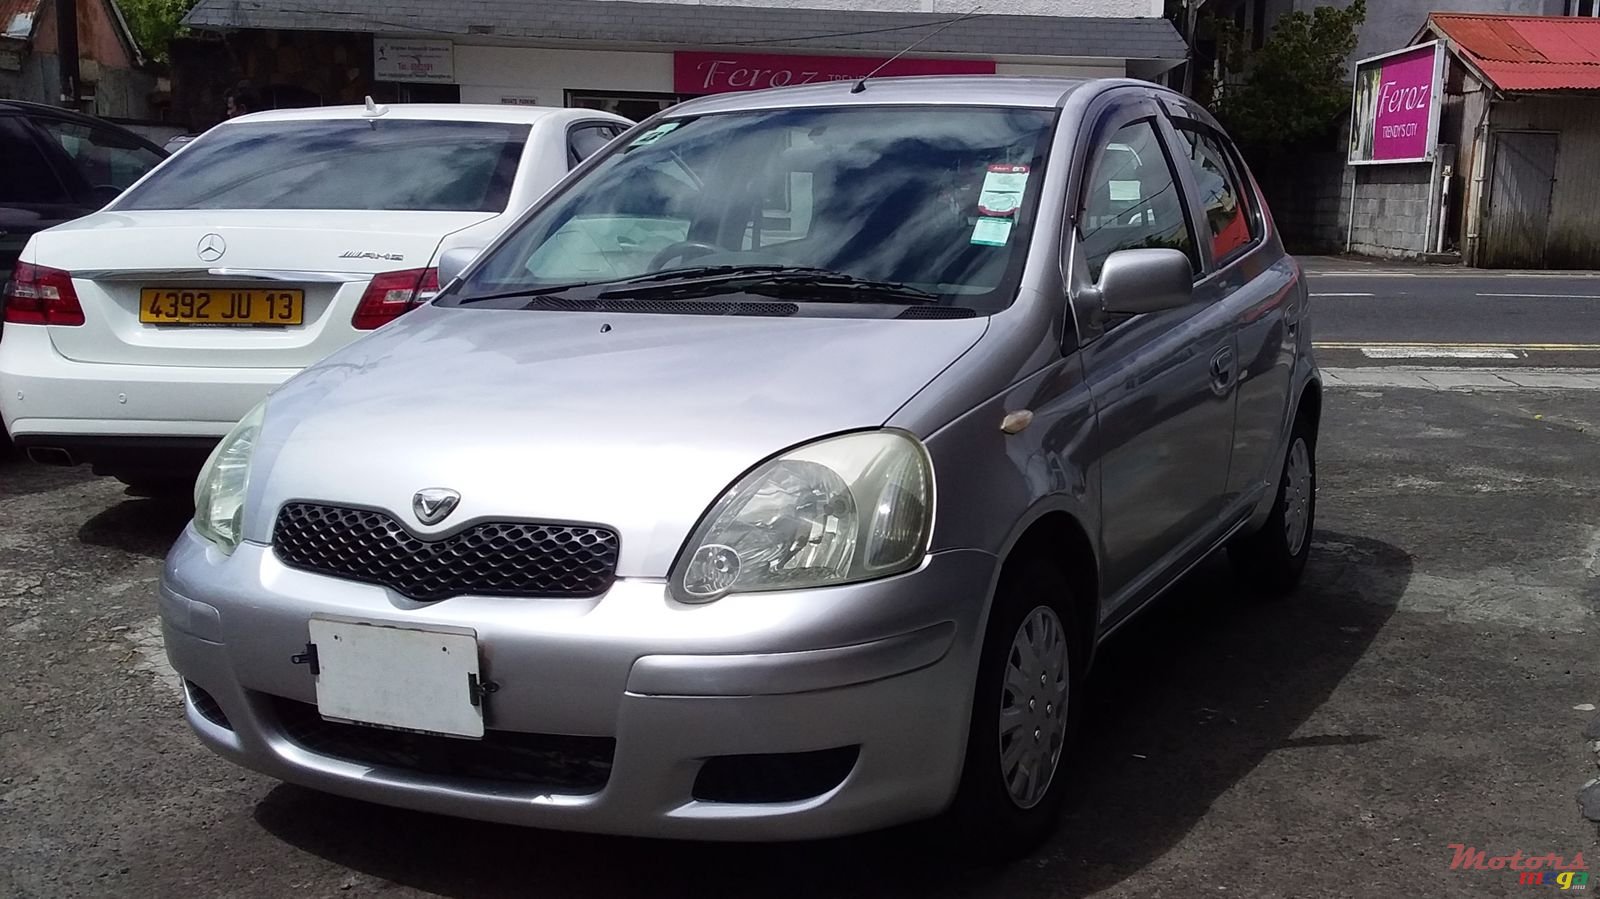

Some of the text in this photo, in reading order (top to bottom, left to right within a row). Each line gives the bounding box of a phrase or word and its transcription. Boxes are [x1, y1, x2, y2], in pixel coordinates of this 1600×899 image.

[697, 60, 818, 88] Feroz
[1379, 81, 1429, 118] Feroz
[1382, 122, 1418, 139] TRENDY'S CITY
[149, 293, 293, 319] 4392 JU 13
